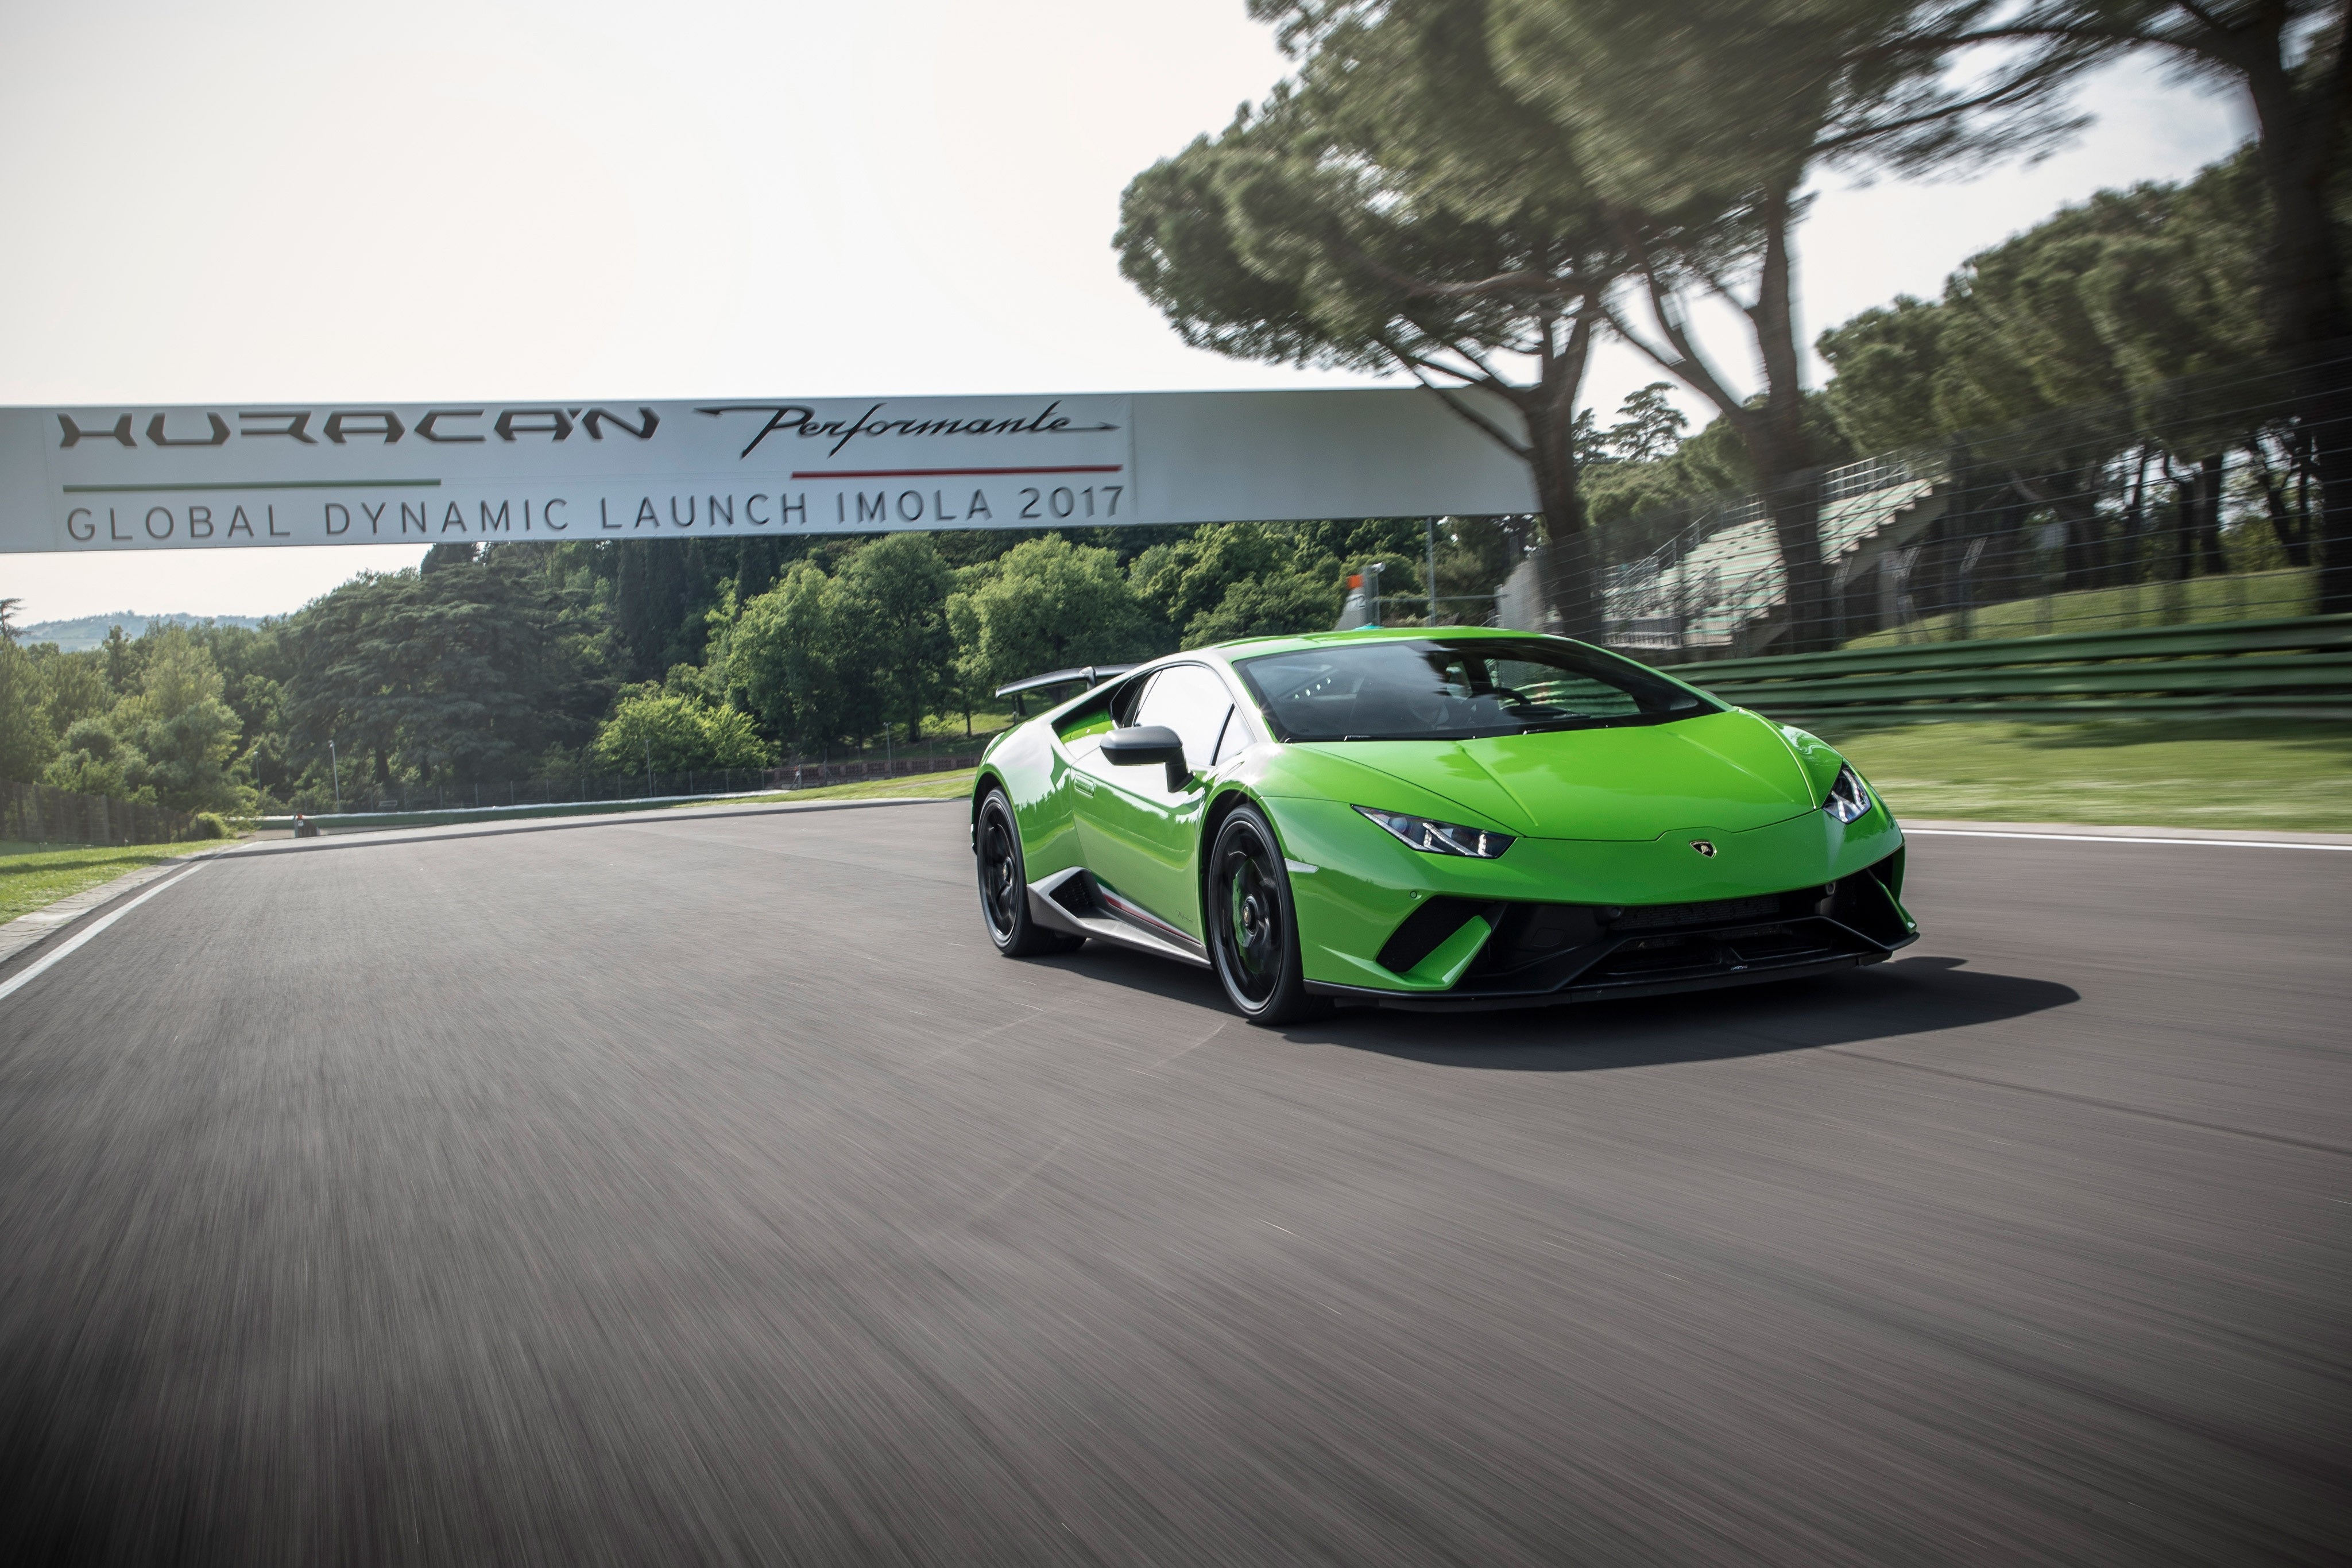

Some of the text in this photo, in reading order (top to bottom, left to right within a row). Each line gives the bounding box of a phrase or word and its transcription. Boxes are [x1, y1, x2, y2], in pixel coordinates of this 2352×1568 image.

[693, 400, 1121, 460] Performante
[67, 486, 1124, 541] GLOBAL DYNAMIC LAUNCH IMOLA 2017
